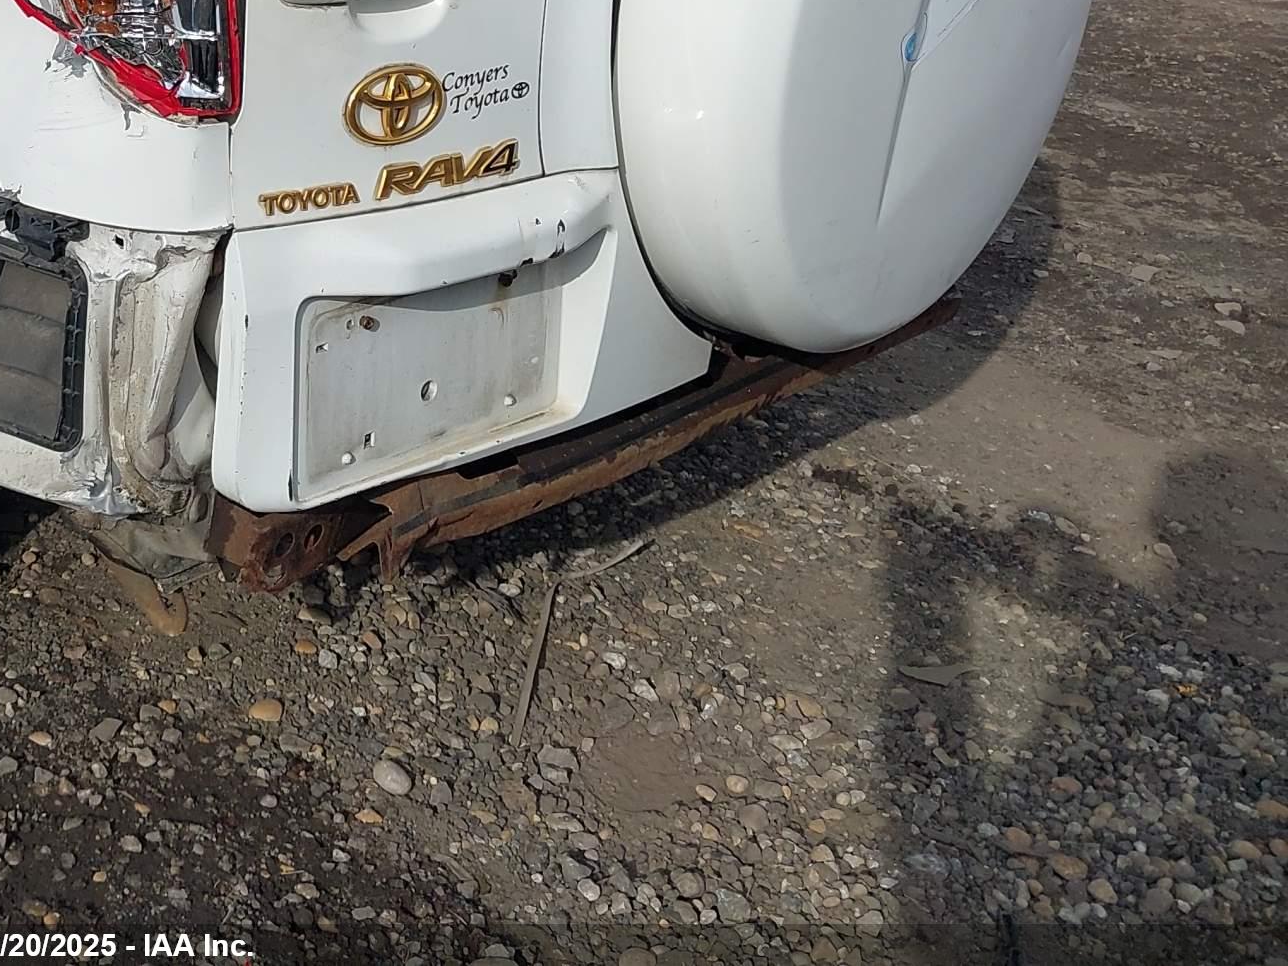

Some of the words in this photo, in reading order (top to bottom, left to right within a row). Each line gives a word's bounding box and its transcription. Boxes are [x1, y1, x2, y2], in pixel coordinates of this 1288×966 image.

[442, 63, 509, 93] Conyers
[450, 86, 509, 120] Toyota
[259, 183, 360, 216] TOYOTA
[376, 138, 520, 201] RAV4
